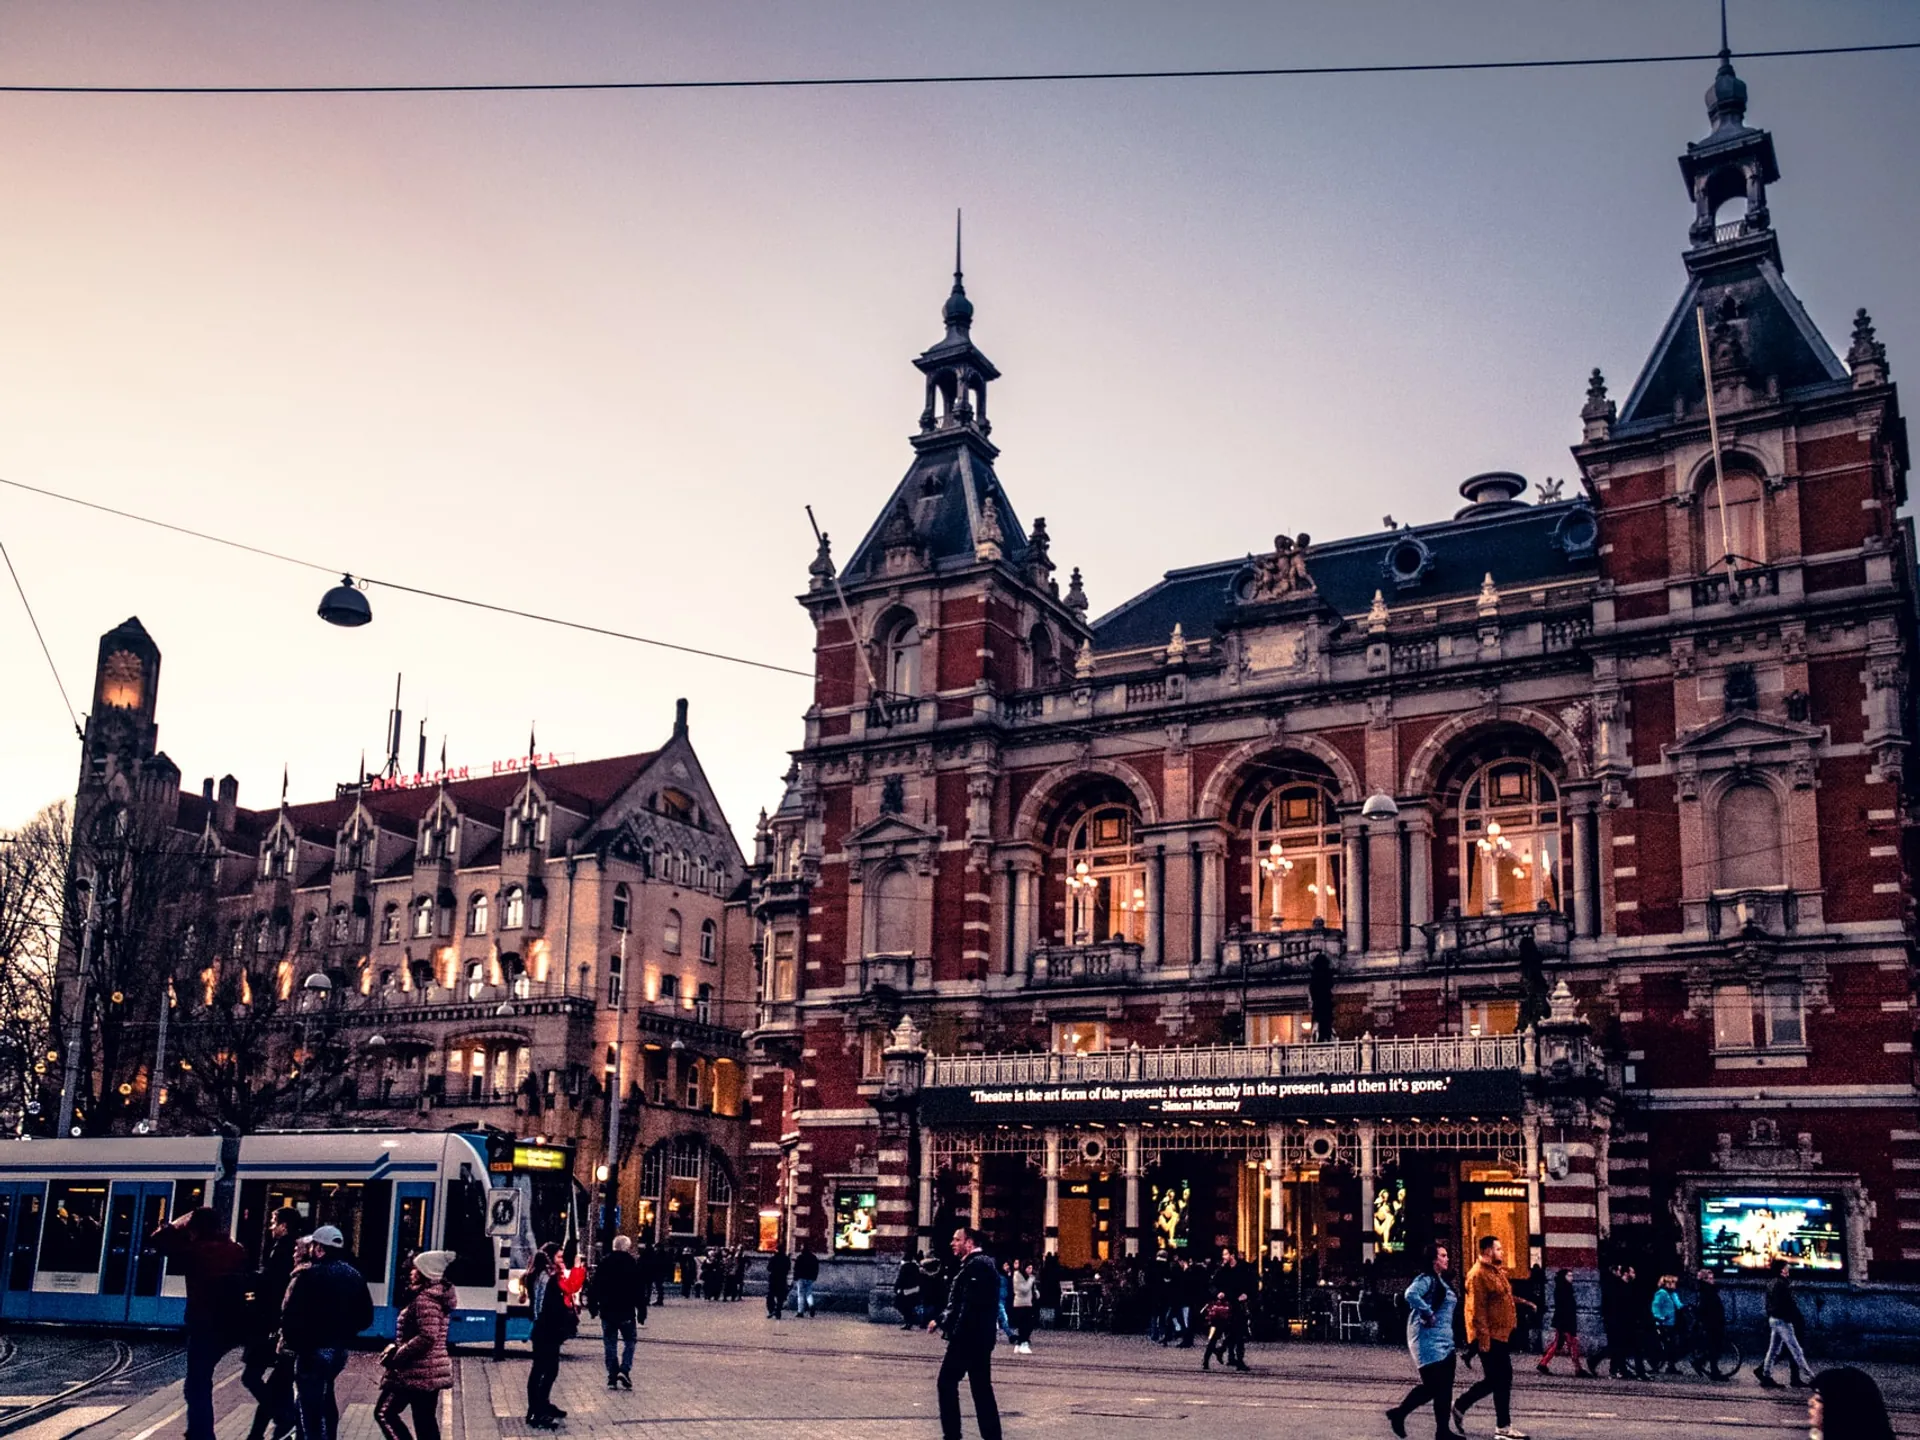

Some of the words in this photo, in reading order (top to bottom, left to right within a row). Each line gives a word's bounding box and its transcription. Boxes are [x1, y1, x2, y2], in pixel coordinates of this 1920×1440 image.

[371, 765, 469, 792] AMERICAN
[492, 751, 559, 772] HOTEL
[1014, 1089, 1024, 1102] is
[1025, 1089, 1043, 1102] the
[1044, 1089, 1060, 1102] art
[1061, 1088, 1087, 1101] form
[1088, 1087, 1101, 1100] of
[1102, 1087, 1121, 1100] the
[1121, 1086, 1167, 1102] present:
[1168, 1085, 1178, 1098] it
[1179, 1084, 1213, 1098] exists
[1214, 1083, 1241, 1099] only
[1242, 1083, 1255, 1096] in
[1257, 1082, 1277, 1096] the
[1278, 1081, 1329, 1098] present,
[1330, 1080, 1355, 1094] and
[1357, 1079, 1387, 1093] then
[1388, 1078, 1409, 1093] it's
[1161, 1100, 1192, 1112] Simon
[1192, 1099, 1241, 1112] McBurney
